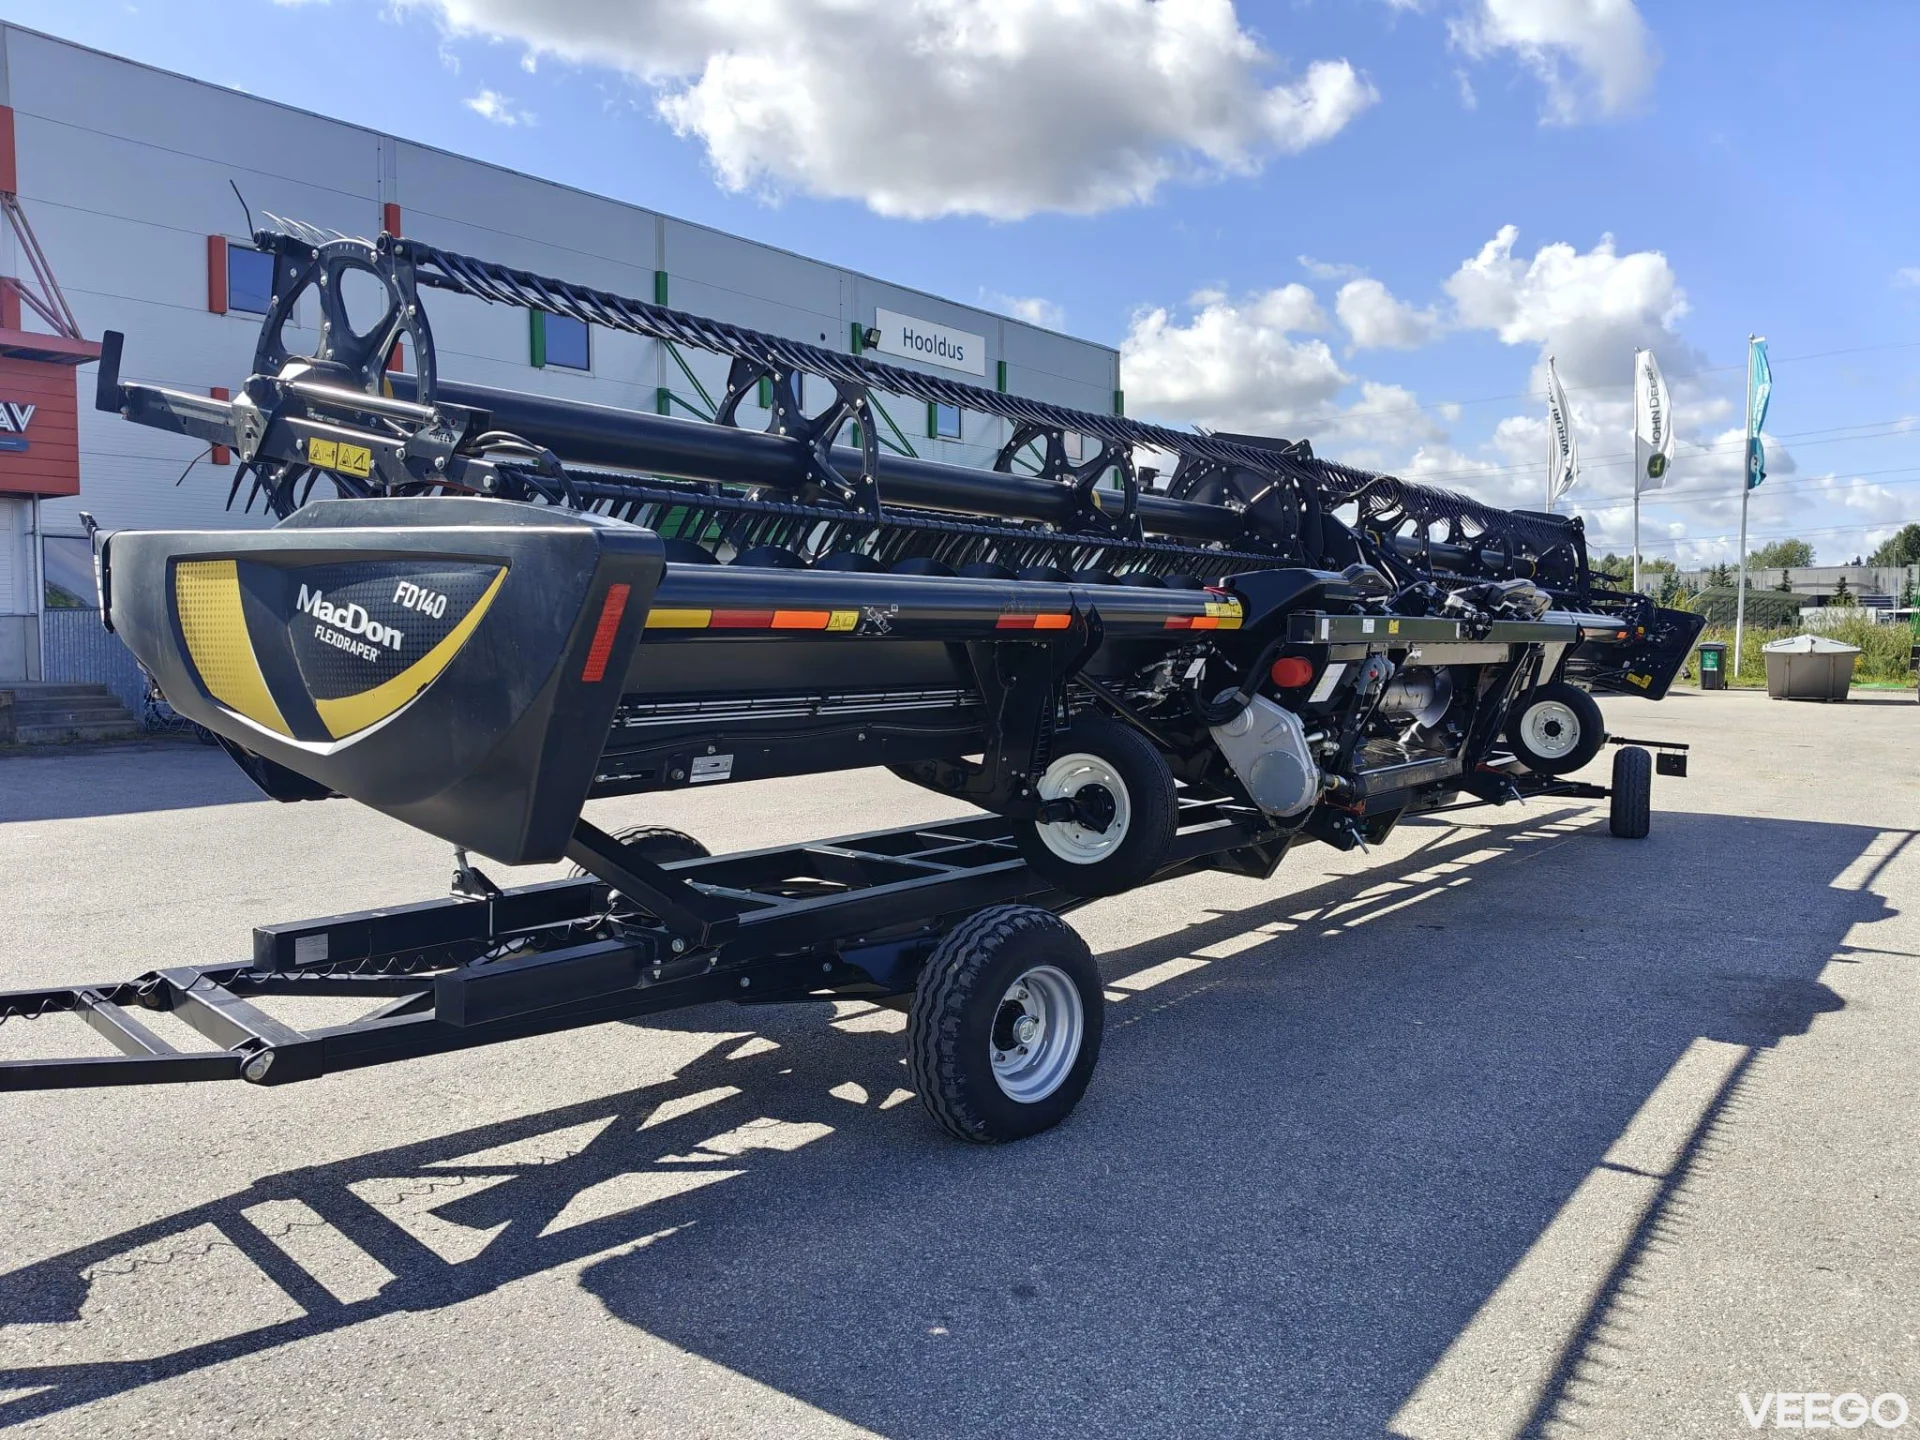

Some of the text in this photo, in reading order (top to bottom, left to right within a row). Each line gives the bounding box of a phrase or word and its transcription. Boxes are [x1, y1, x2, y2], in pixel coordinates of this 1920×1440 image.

[903, 327, 964, 361] Hooldus
[1552, 408, 1570, 456] WIHURI
[296, 583, 402, 651] MacDon
[392, 581, 448, 619] FD140
[314, 625, 379, 663] FLEXDRAPER
